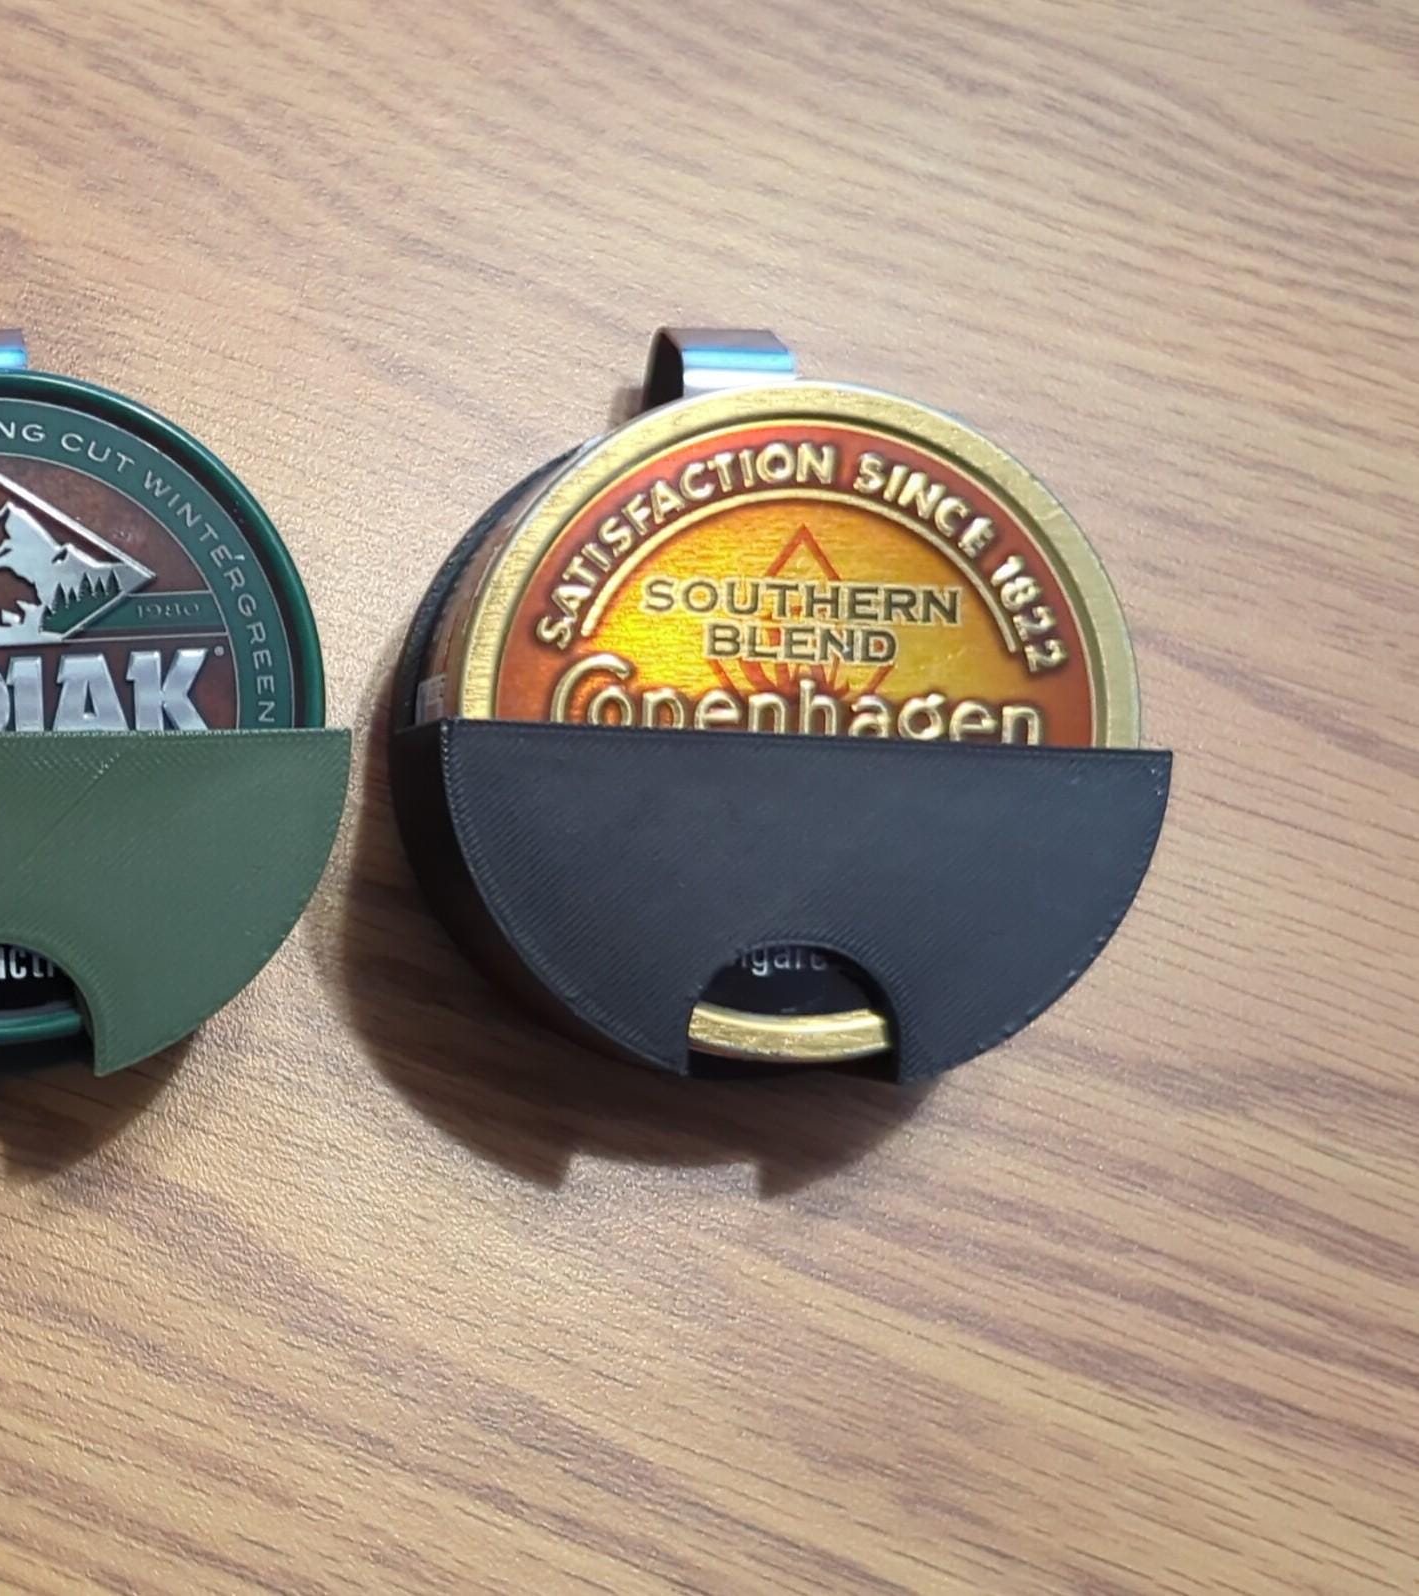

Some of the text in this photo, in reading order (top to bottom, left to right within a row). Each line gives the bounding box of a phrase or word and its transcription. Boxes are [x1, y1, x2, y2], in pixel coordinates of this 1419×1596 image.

[60, 432, 135, 473] CUT
[143, 469, 276, 723] WINTERGREEN
[536, 442, 1068, 673] SATISFACTION SINCE 1822
[641, 576, 962, 626] SOUTHERN
[705, 621, 899, 665] BLEND
